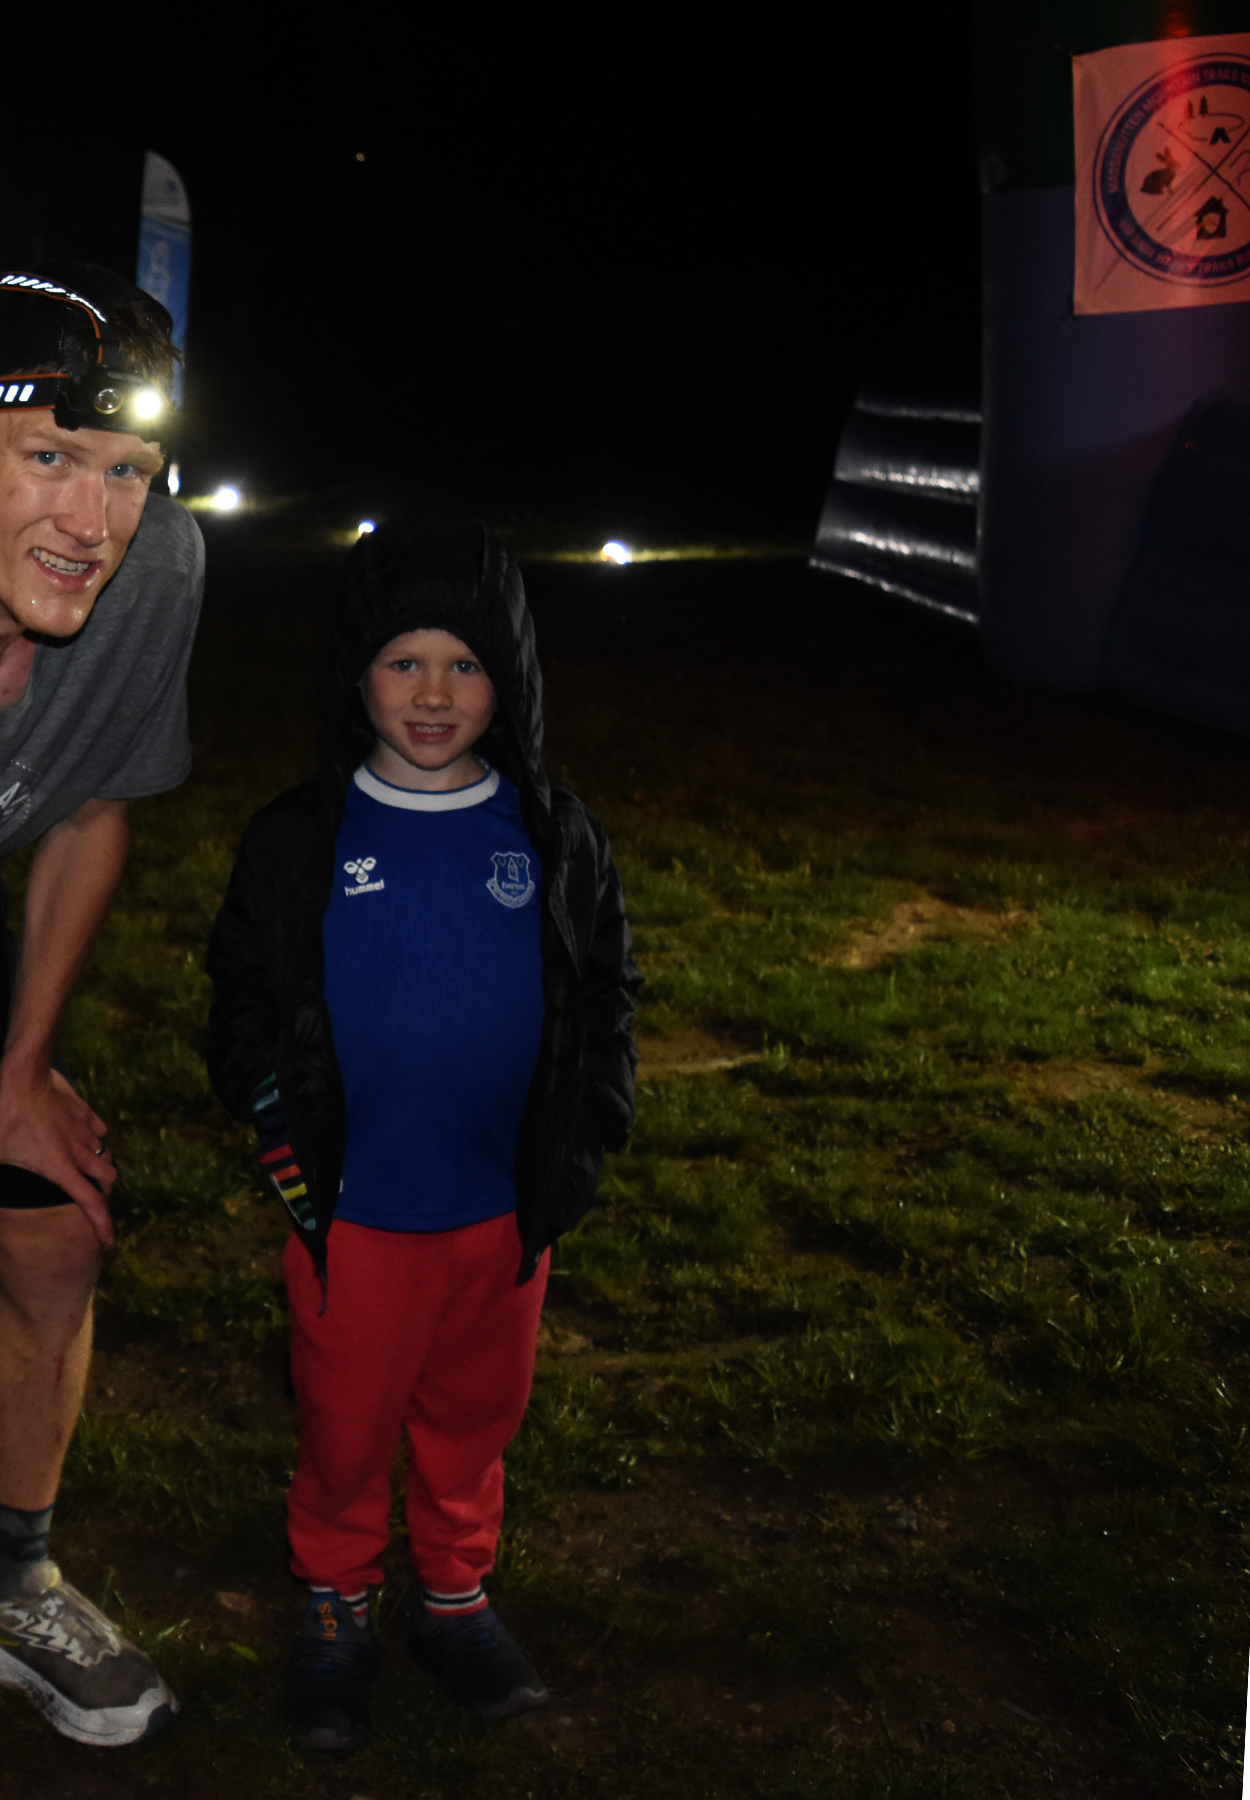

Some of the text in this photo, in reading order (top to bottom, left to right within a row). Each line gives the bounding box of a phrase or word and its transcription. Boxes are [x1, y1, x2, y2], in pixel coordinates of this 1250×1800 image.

[1203, 68, 1239, 81] TRAILS
[1199, 257, 1235, 273] TRAILS
[344, 878, 385, 897] hummel
